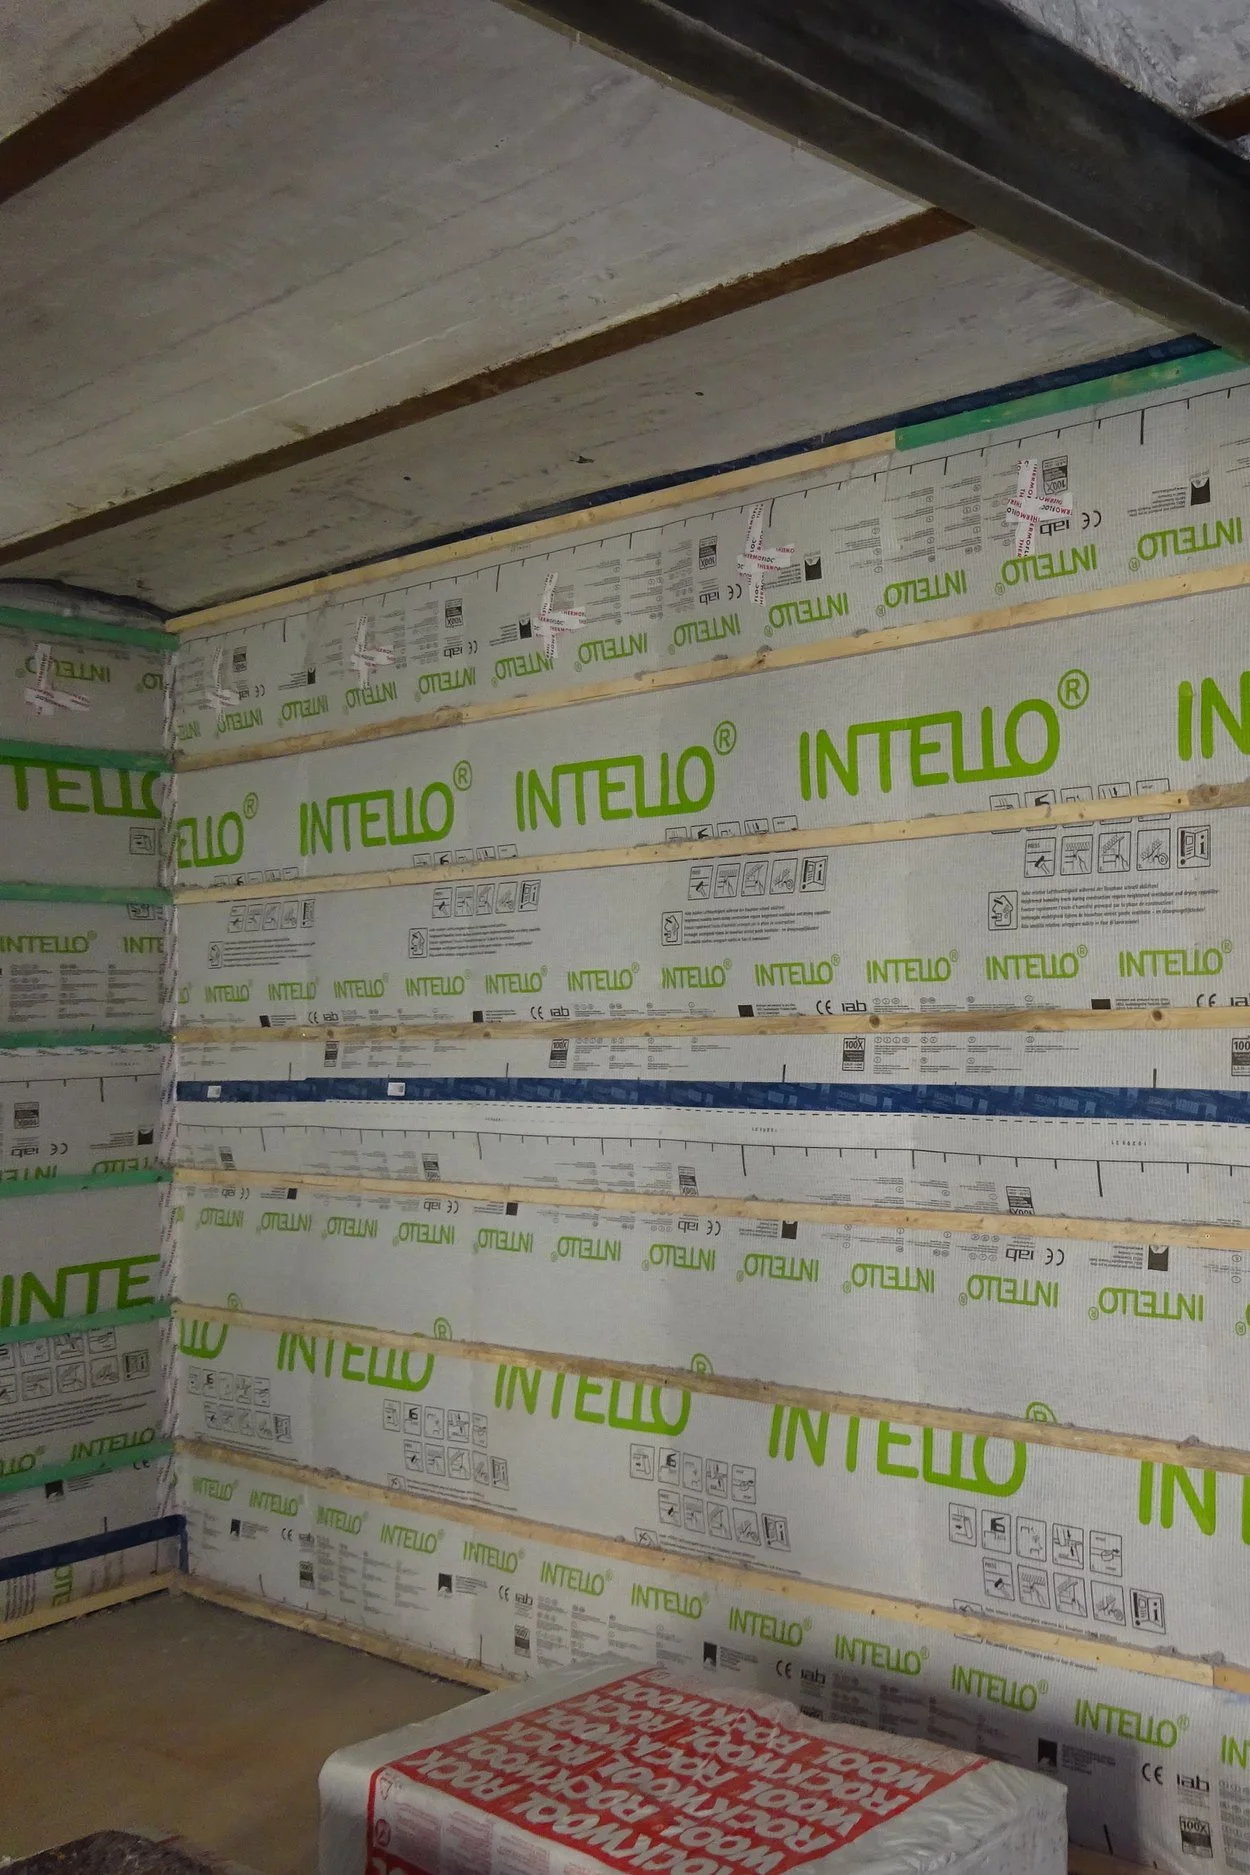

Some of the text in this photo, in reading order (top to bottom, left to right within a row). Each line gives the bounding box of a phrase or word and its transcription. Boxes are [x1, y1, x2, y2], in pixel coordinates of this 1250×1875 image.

[814, 1745, 936, 1795] WOOL
[511, 1791, 733, 1875] OCKWOOL
[731, 1779, 862, 1835] WOOL
